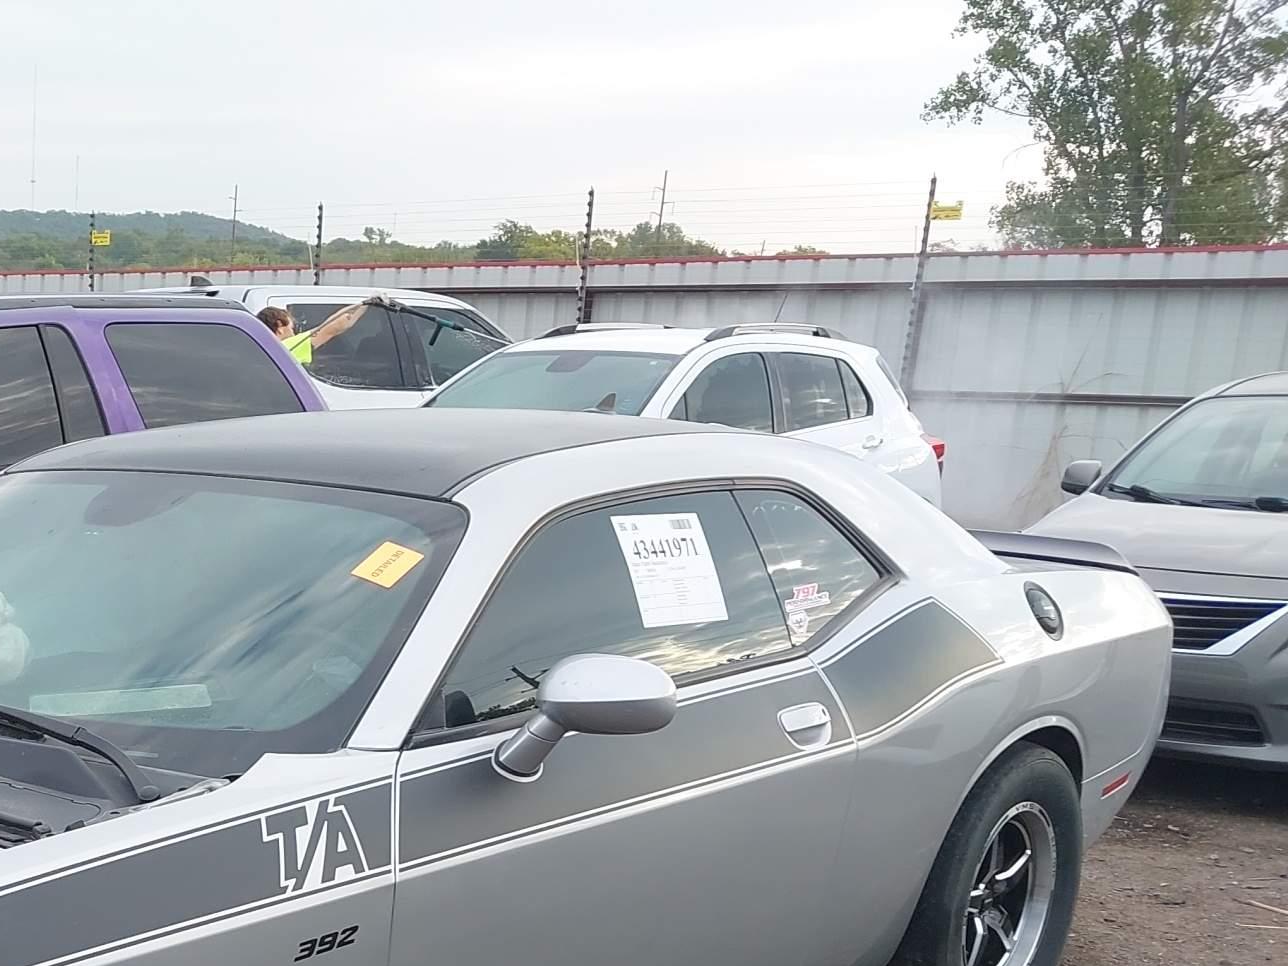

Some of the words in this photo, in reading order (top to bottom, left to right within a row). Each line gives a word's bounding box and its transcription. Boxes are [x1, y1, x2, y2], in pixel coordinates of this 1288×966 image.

[633, 537, 700, 560] 43441971
[795, 585, 816, 599] 797
[261, 797, 369, 893] T/A
[293, 925, 359, 962] 392
